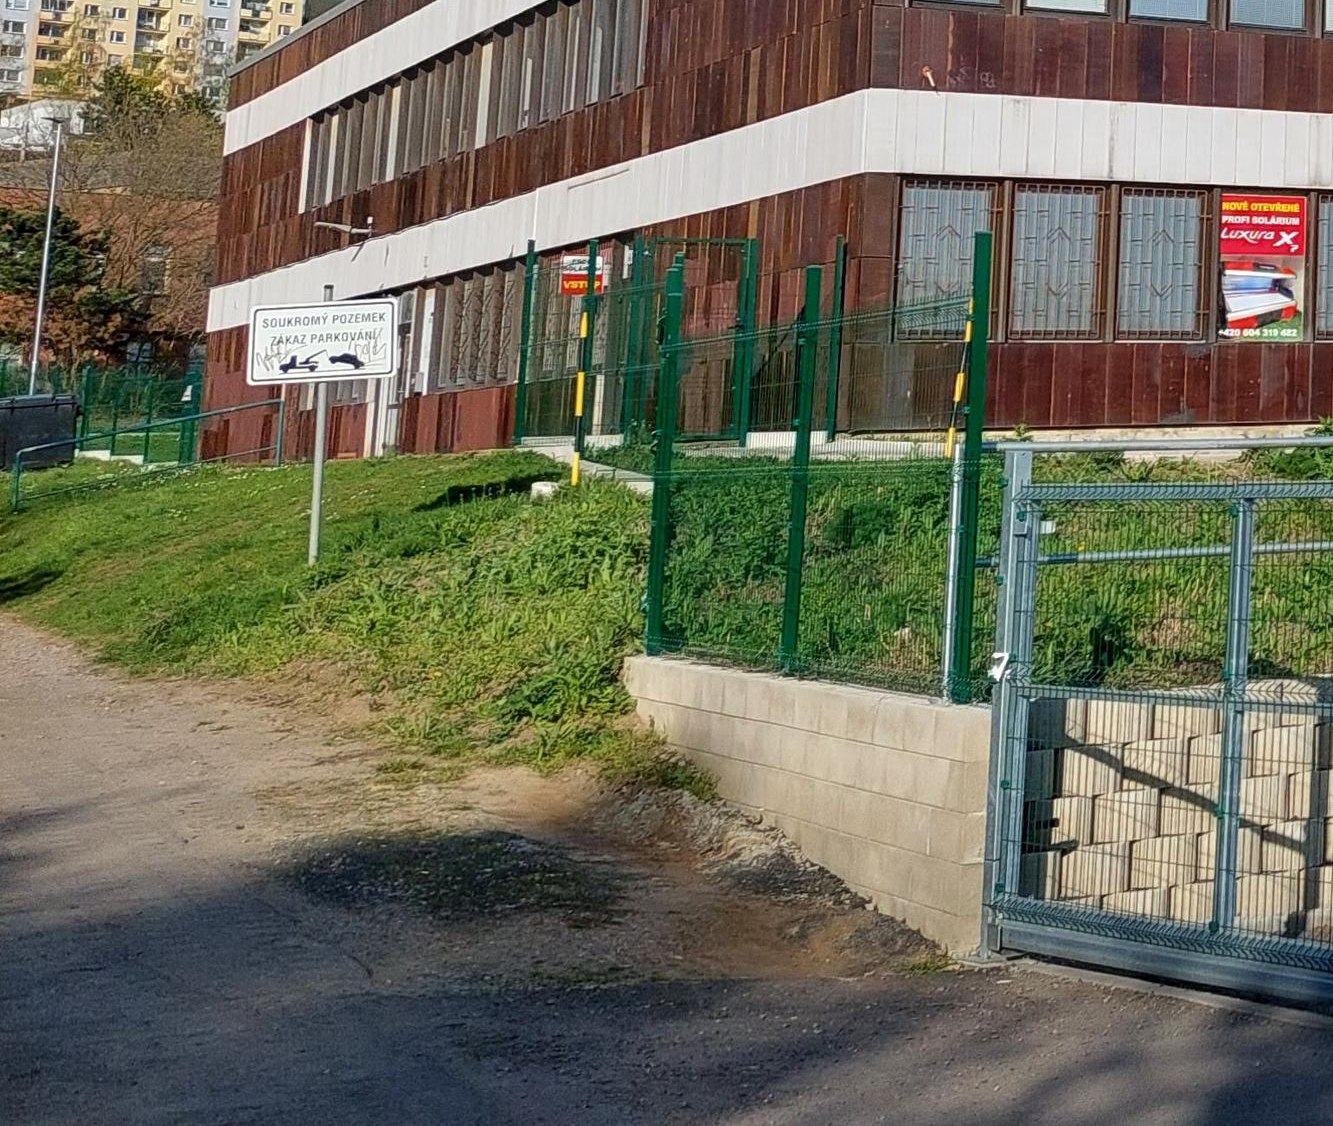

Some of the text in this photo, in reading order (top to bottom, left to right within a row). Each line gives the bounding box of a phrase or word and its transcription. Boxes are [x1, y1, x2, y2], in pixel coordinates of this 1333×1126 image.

[1222, 201, 1249, 210] NOVÉ
[1222, 215, 1300, 225] PROFI SOLÁRIUM
[1220, 227, 1275, 244] Luxura
[262, 312, 386, 329] SOUKROMÝ POZEMEK
[270, 329, 377, 346] ZÁKAZ PARKOVÁNÍ
[1218, 328, 1240, 337] +420
